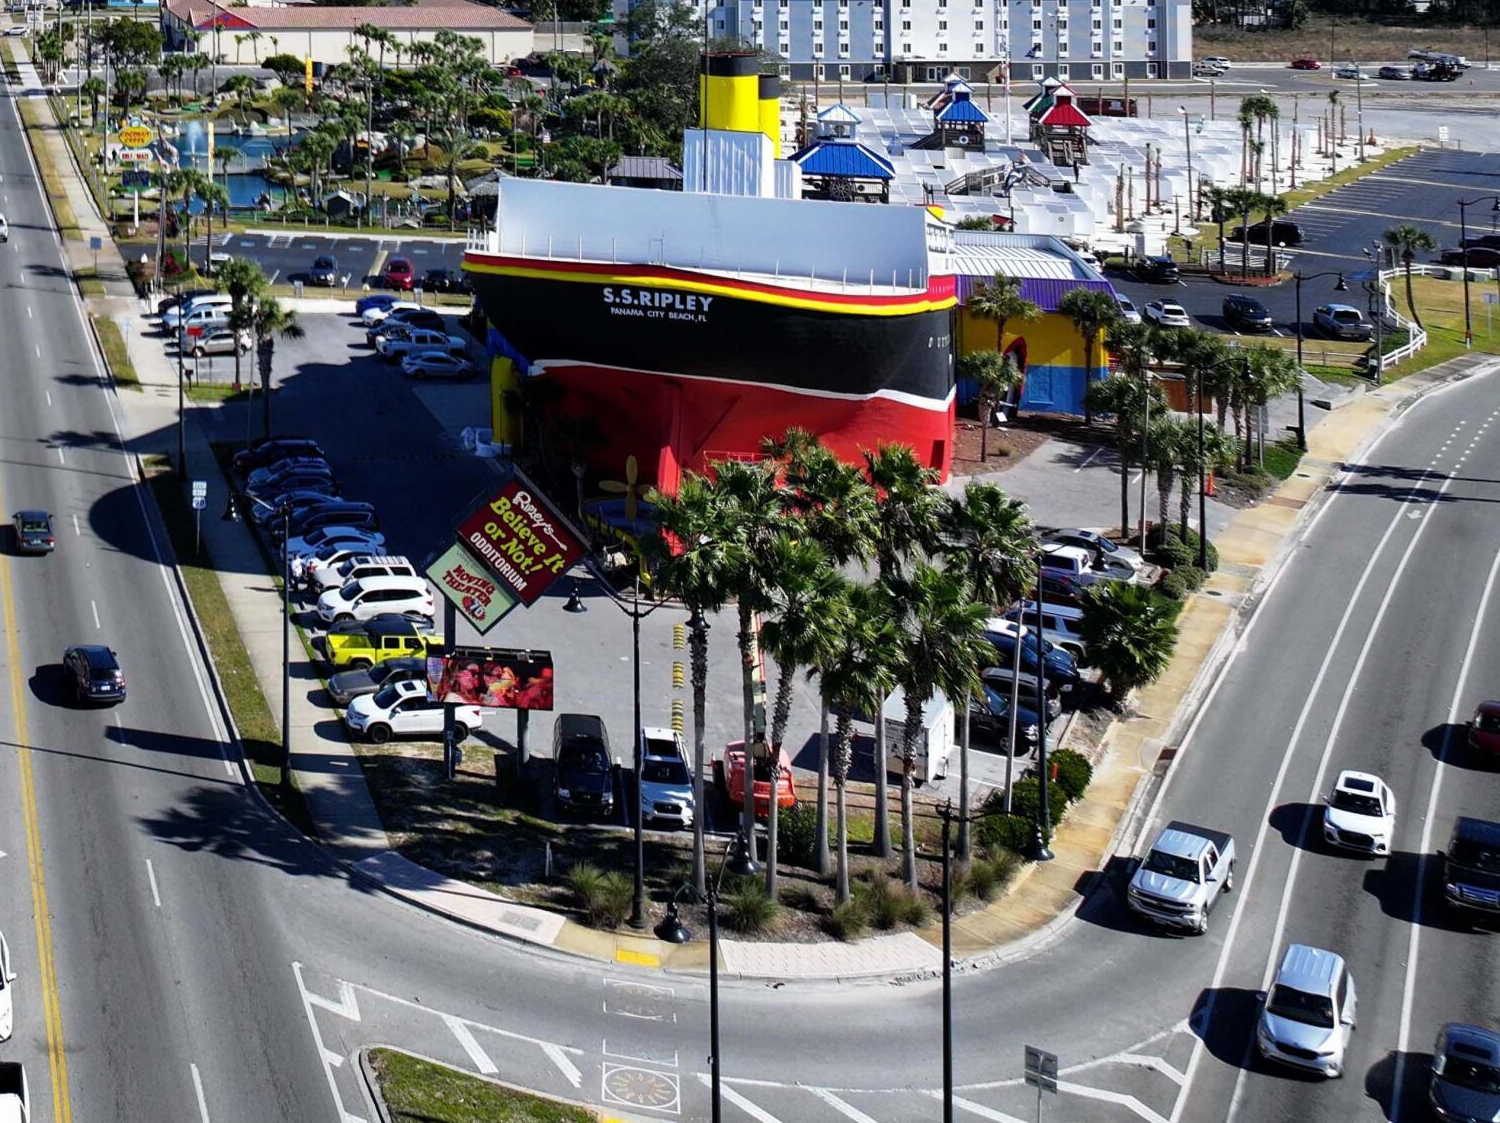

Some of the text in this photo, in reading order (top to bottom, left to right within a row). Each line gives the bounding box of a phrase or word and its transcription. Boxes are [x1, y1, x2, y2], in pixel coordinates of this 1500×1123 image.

[611, 307, 644, 317] PANAMA
[647, 310, 665, 318] CITY
[484, 522, 506, 540] or
[500, 538, 543, 575] Not!
[490, 497, 565, 574] Believe It
[453, 564, 495, 596] MOVING
[470, 532, 527, 591] ODDITORIUM
[443, 570, 491, 607] THEATER
[469, 596, 485, 617] 7D
